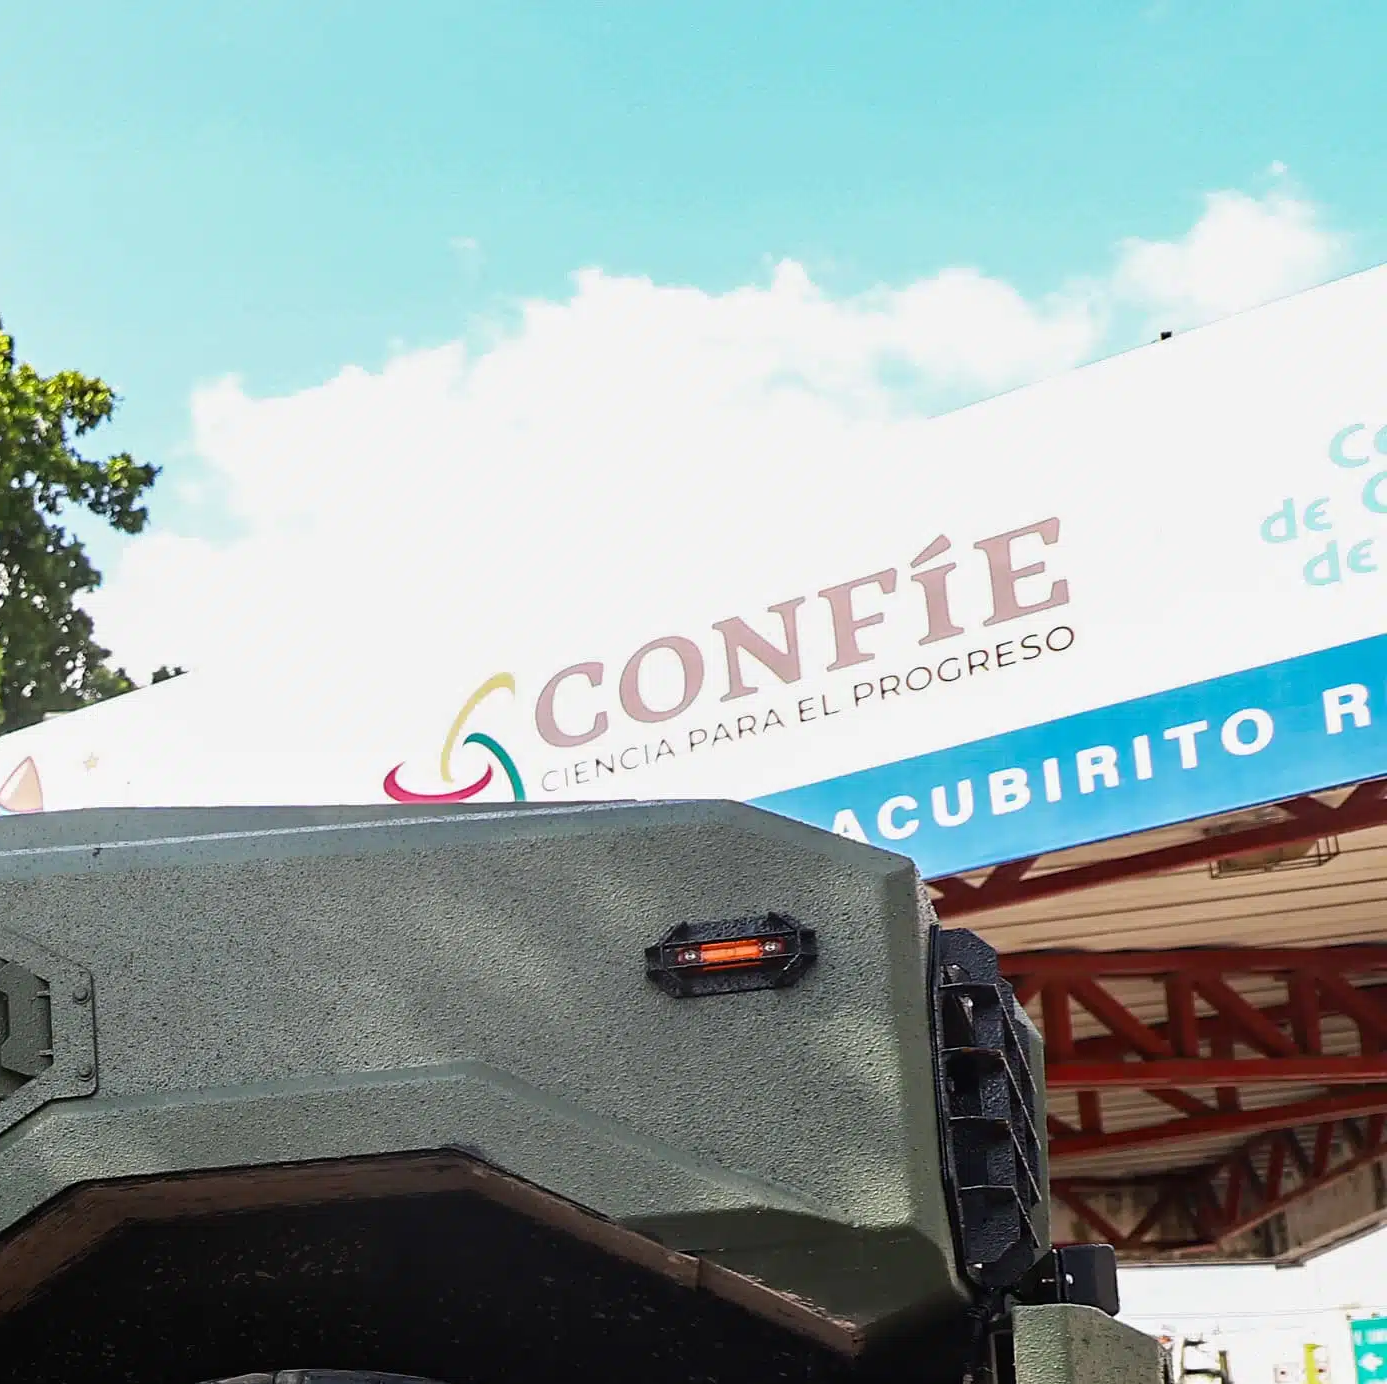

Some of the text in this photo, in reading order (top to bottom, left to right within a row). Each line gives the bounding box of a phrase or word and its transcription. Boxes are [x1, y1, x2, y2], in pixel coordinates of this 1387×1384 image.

[534, 517, 1070, 748] CONFÍE
[541, 625, 1075, 792] CIENCIA PARA EL PROGRESO
